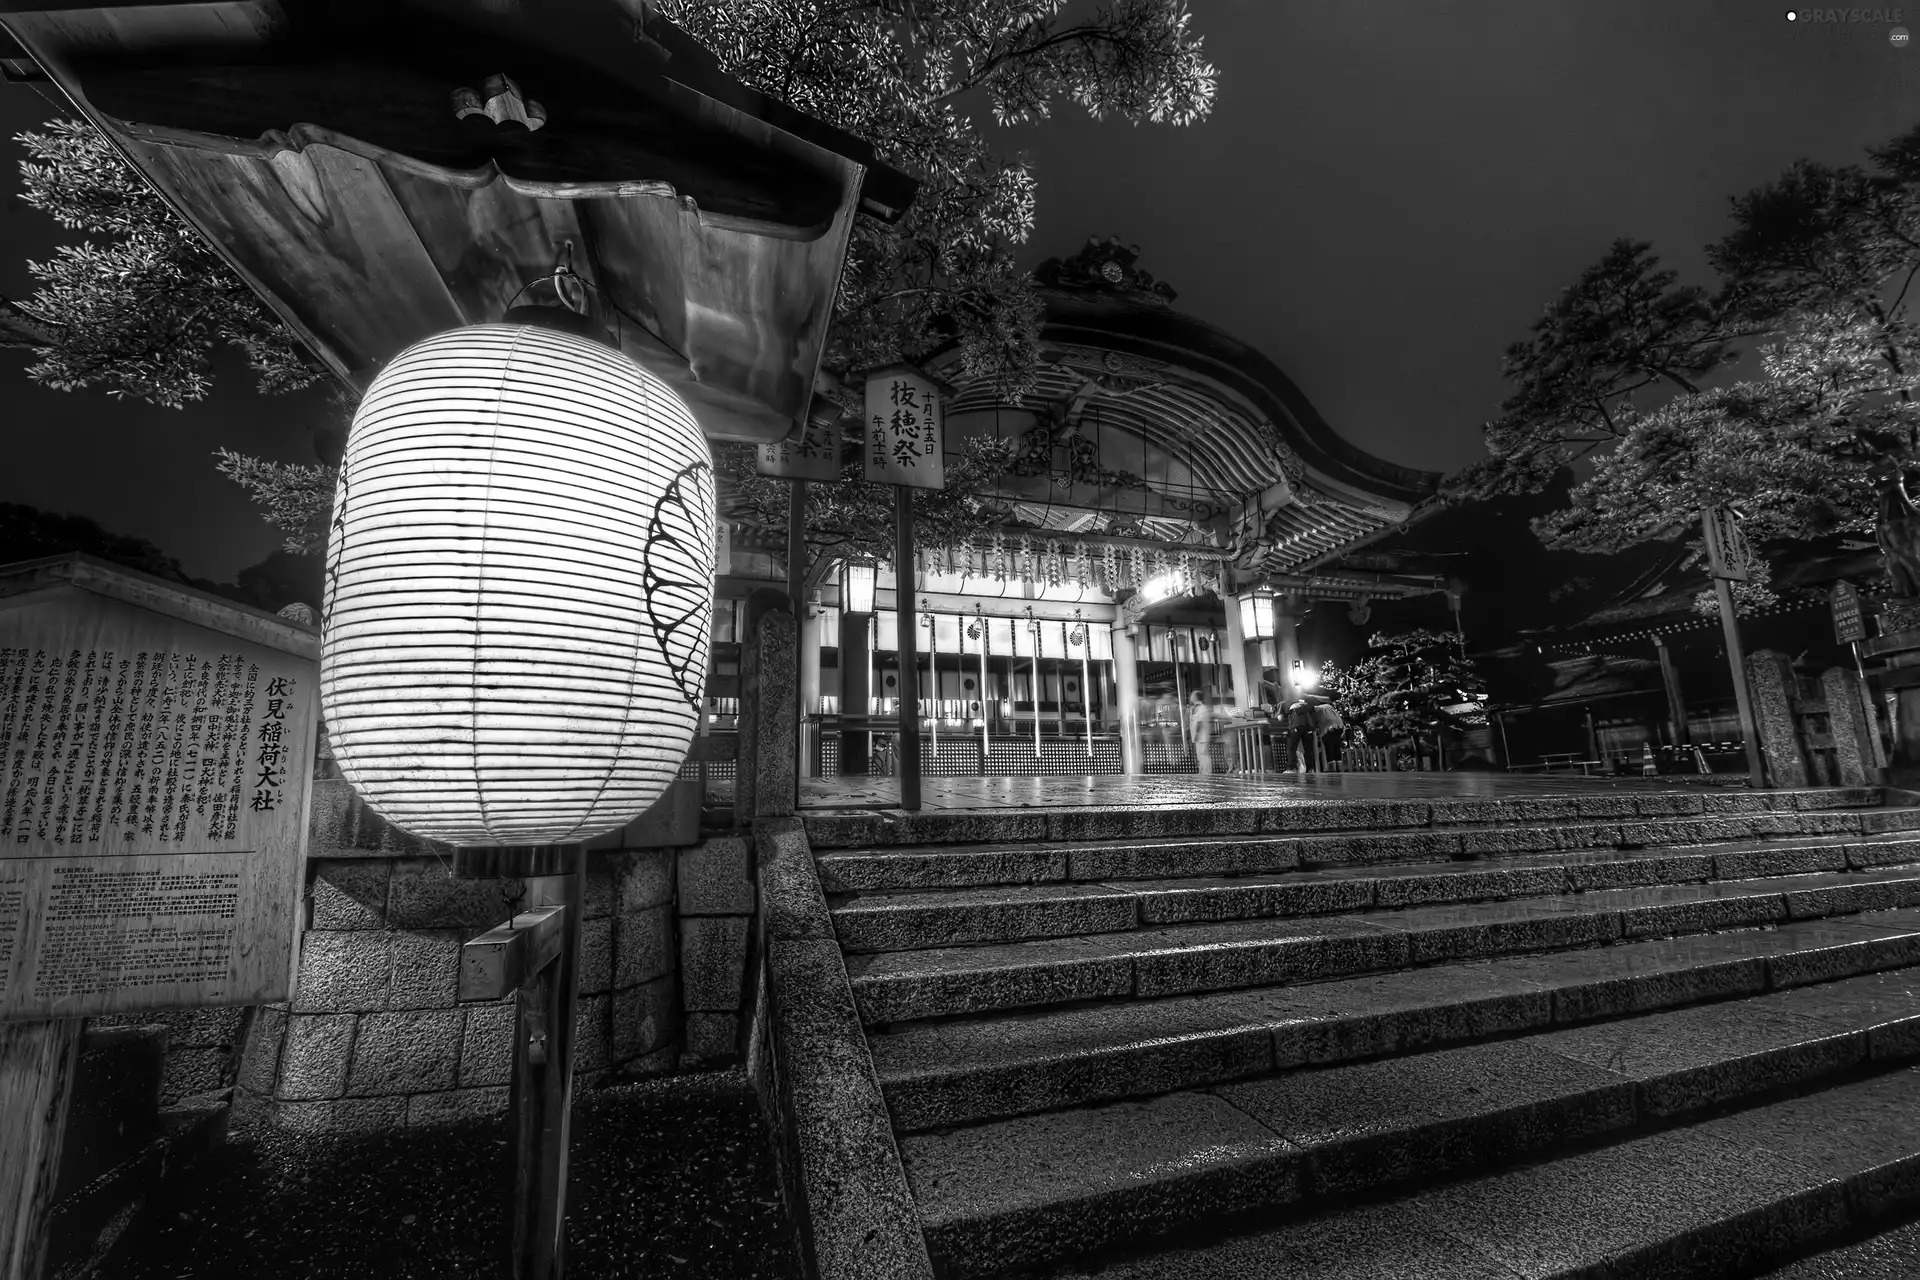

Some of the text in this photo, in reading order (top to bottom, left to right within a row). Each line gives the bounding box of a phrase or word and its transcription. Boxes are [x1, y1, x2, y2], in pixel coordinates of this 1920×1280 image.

[871, 415, 887, 470] 午前十一時
[889, 380, 923, 468] 抜穂祭
[922, 392, 936, 455] 十月二十五日
[249, 677, 289, 813] 伏見稲荷大社
